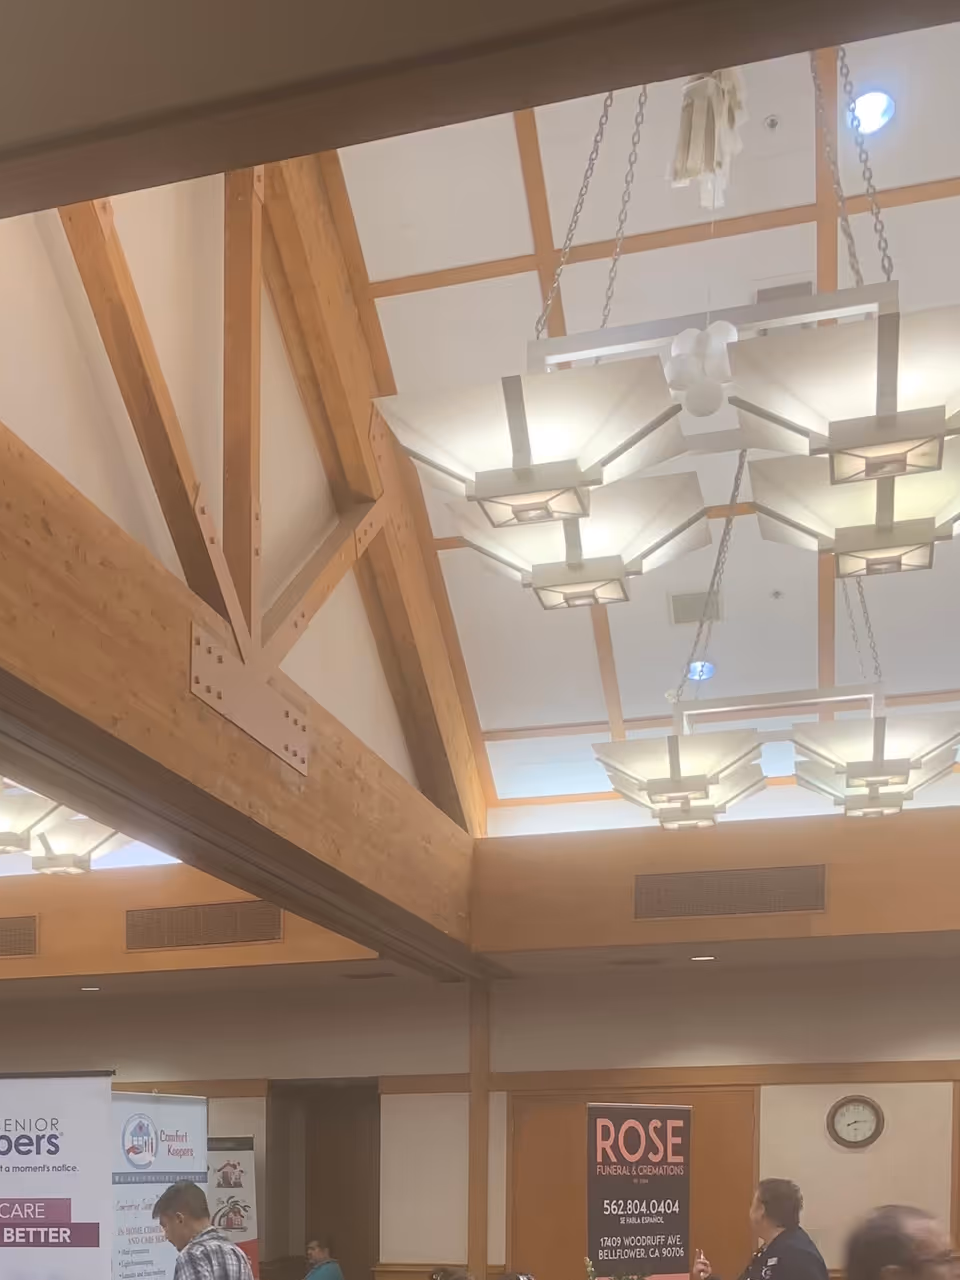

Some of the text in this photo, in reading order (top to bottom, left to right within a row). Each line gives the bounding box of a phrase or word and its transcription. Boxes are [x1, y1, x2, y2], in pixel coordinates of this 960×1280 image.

[596, 1117, 684, 1163] ROSE
[11, 1164, 51, 1173] moment's
[51, 1164, 80, 1173] notice.
[596, 1165, 684, 1176] FUNERAL & CREMATIONS
[603, 1199, 680, 1215] 562.804.0404
[3, 1227, 72, 1243] BETTER
[600, 1235, 682, 1247] 17409 WOODRUFF AVE.
[649, 1248, 660, 1258] CA
[662, 1247, 685, 1257] 90706
